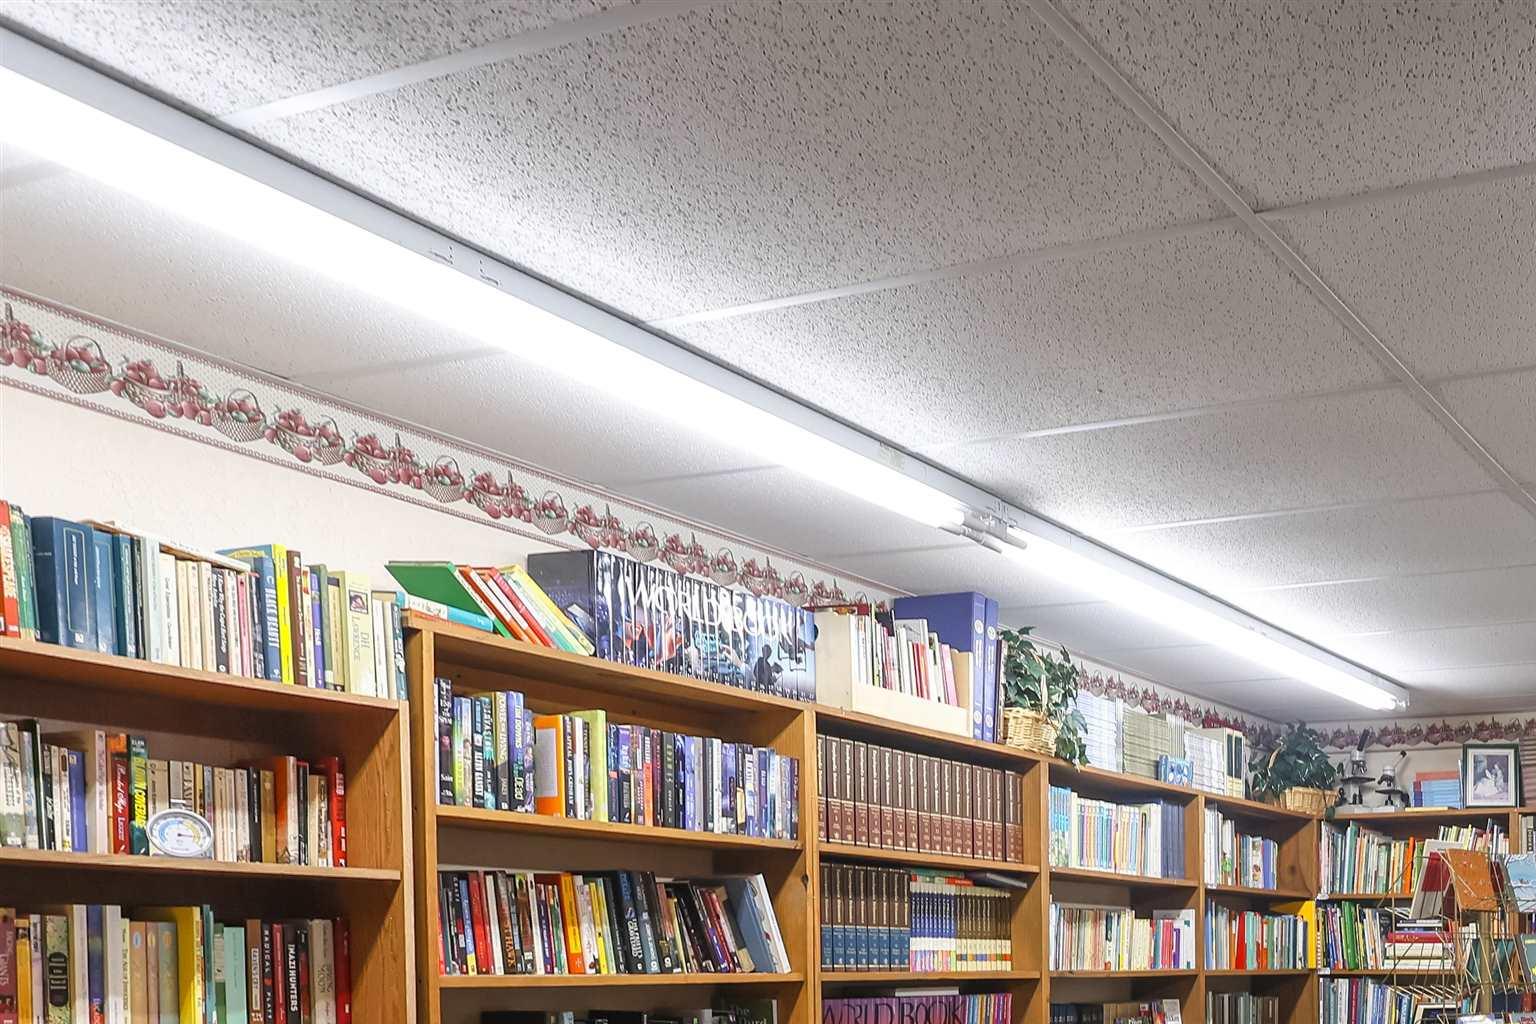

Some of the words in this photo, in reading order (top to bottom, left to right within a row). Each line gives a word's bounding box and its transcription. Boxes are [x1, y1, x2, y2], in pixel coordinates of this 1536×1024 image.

[265, 588, 277, 614] BLACK
[266, 616, 279, 648] BEAUTY
[515, 720, 523, 748] DOWNS
[134, 790, 147, 829] COVERAGE
[289, 970, 298, 1012] HUNTERS
